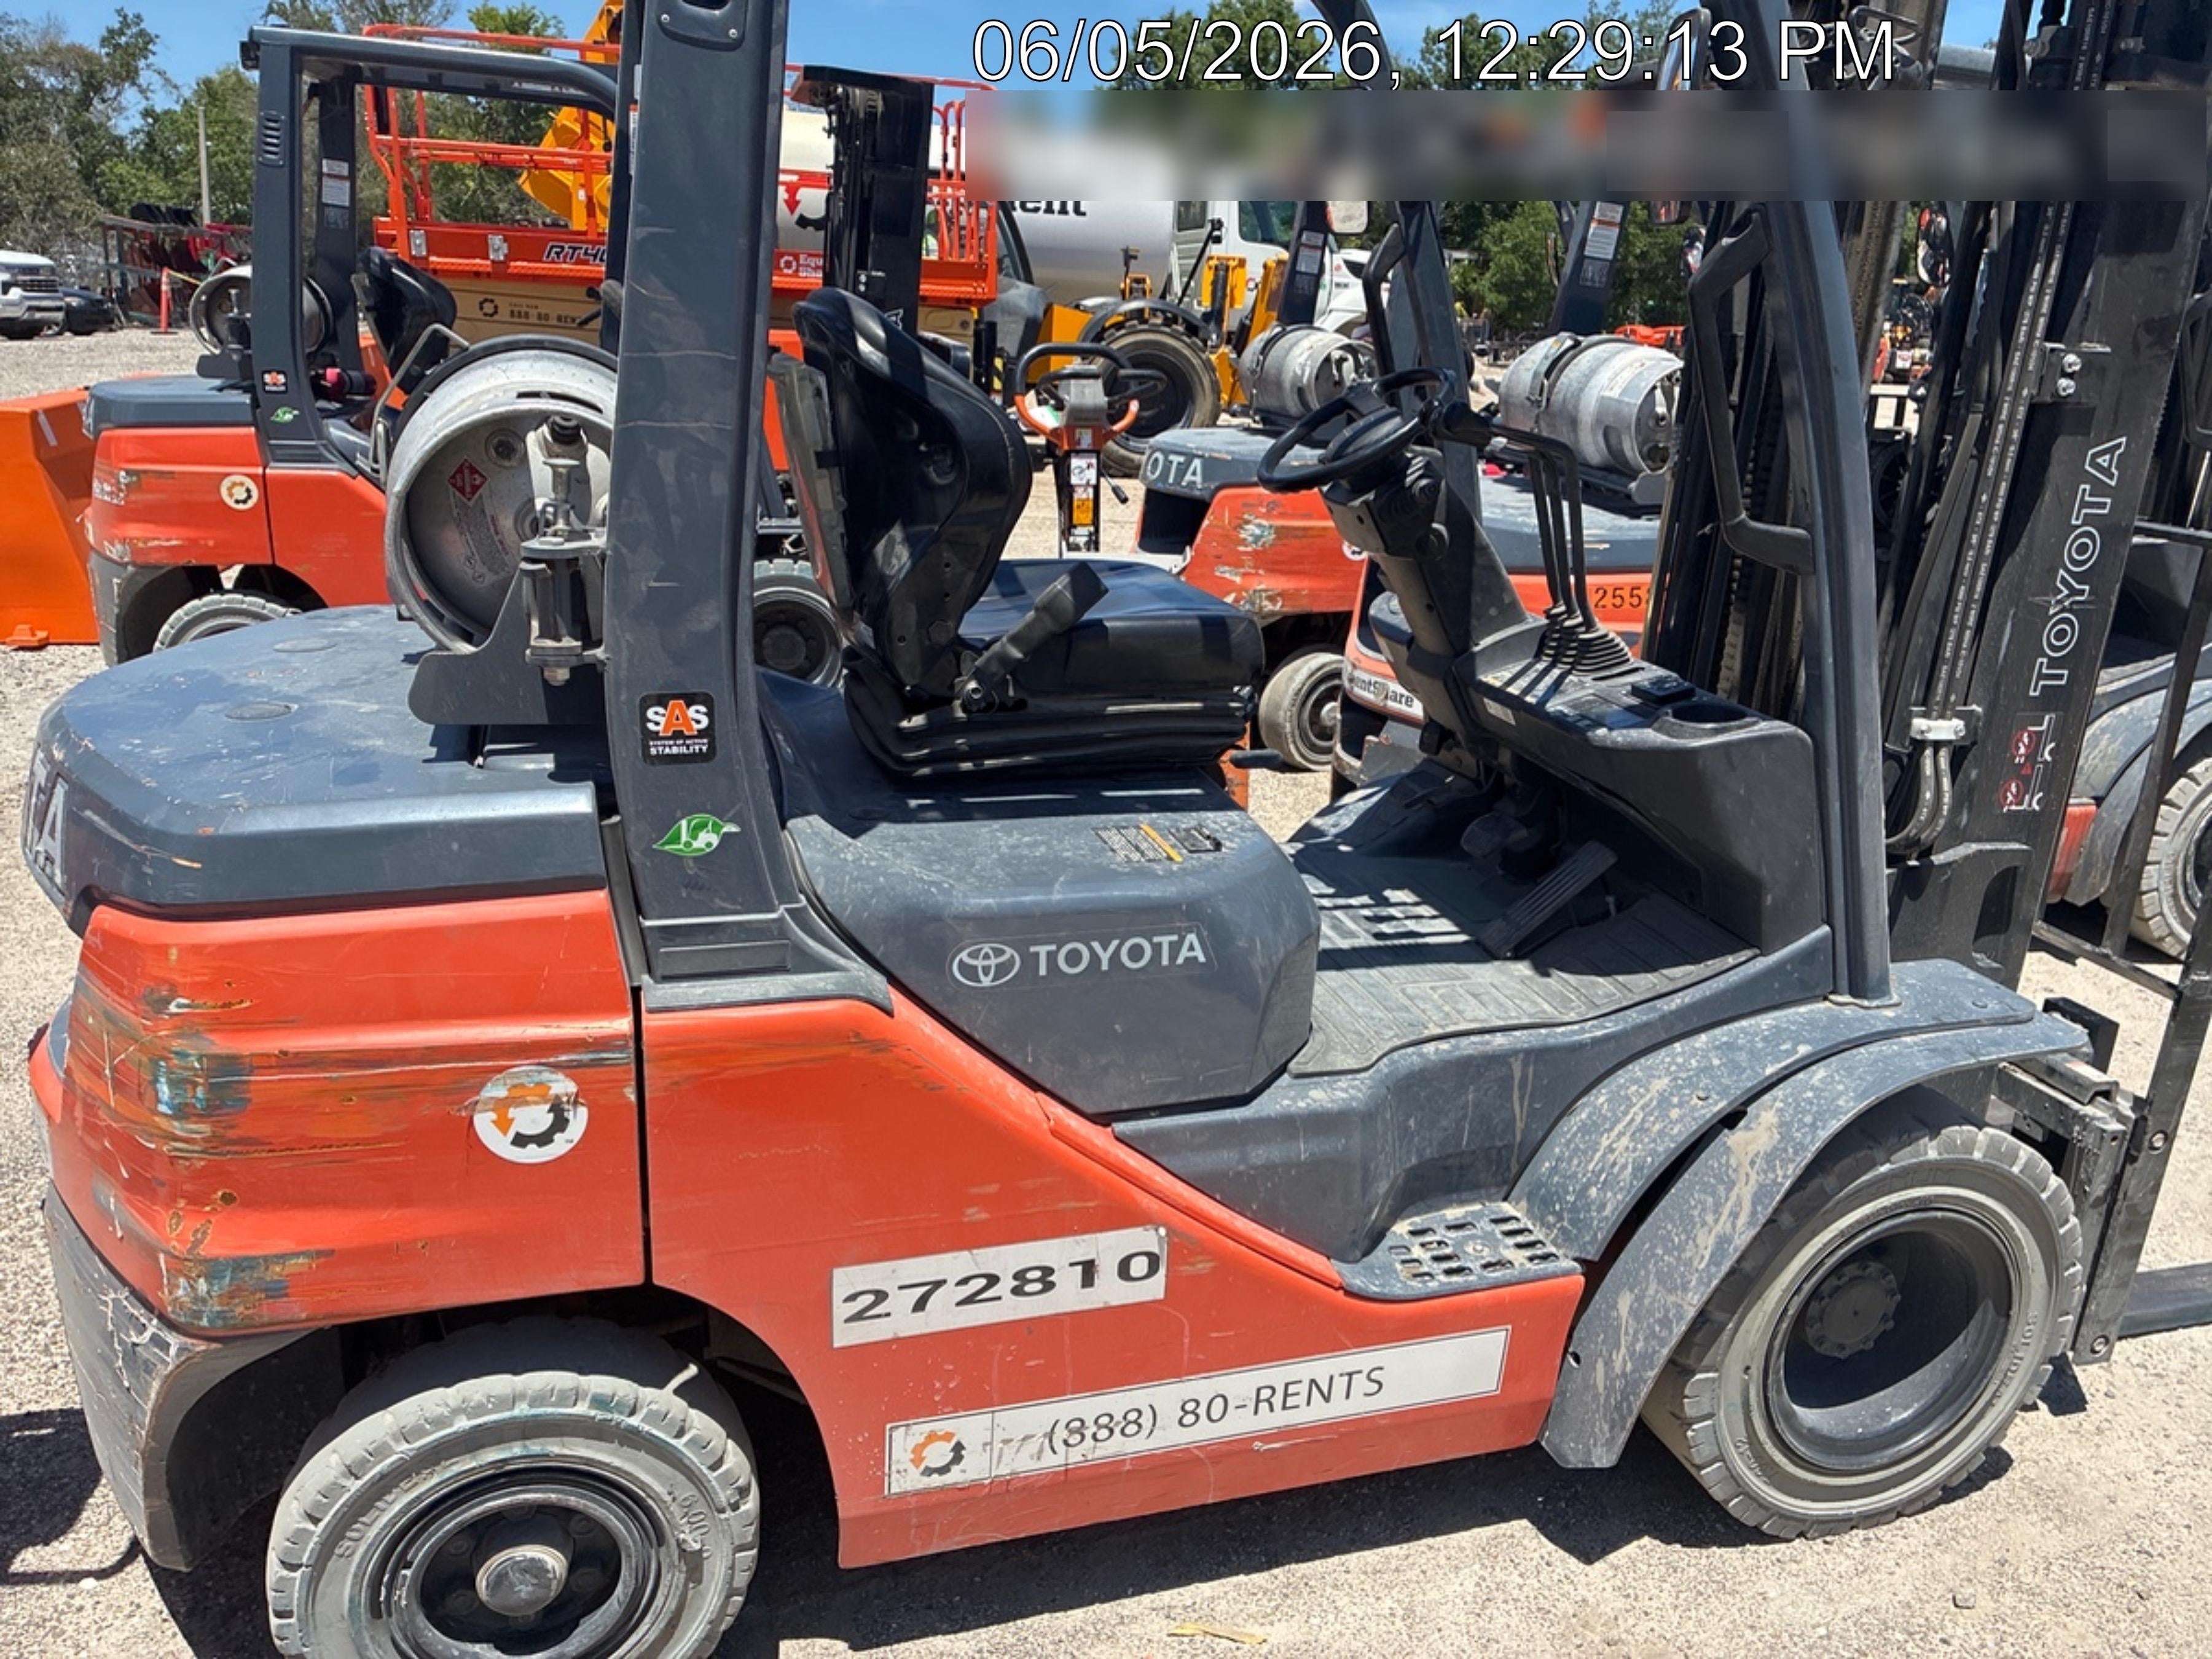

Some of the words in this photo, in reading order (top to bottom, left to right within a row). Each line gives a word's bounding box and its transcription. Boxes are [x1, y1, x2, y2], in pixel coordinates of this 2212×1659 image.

[799, 254, 823, 266] Equ
[1146, 450, 1204, 489] OTA
[2030, 436, 2127, 697] TOYOTA
[646, 700, 709, 736] SAS
[650, 745, 708, 756] STABILITY
[1029, 932, 1206, 976] TOYOTA
[842, 1250, 1161, 1324] 272810
[1048, 1404, 1158, 1455] (888)
[1177, 1365, 1385, 1429] 80-RENTS
